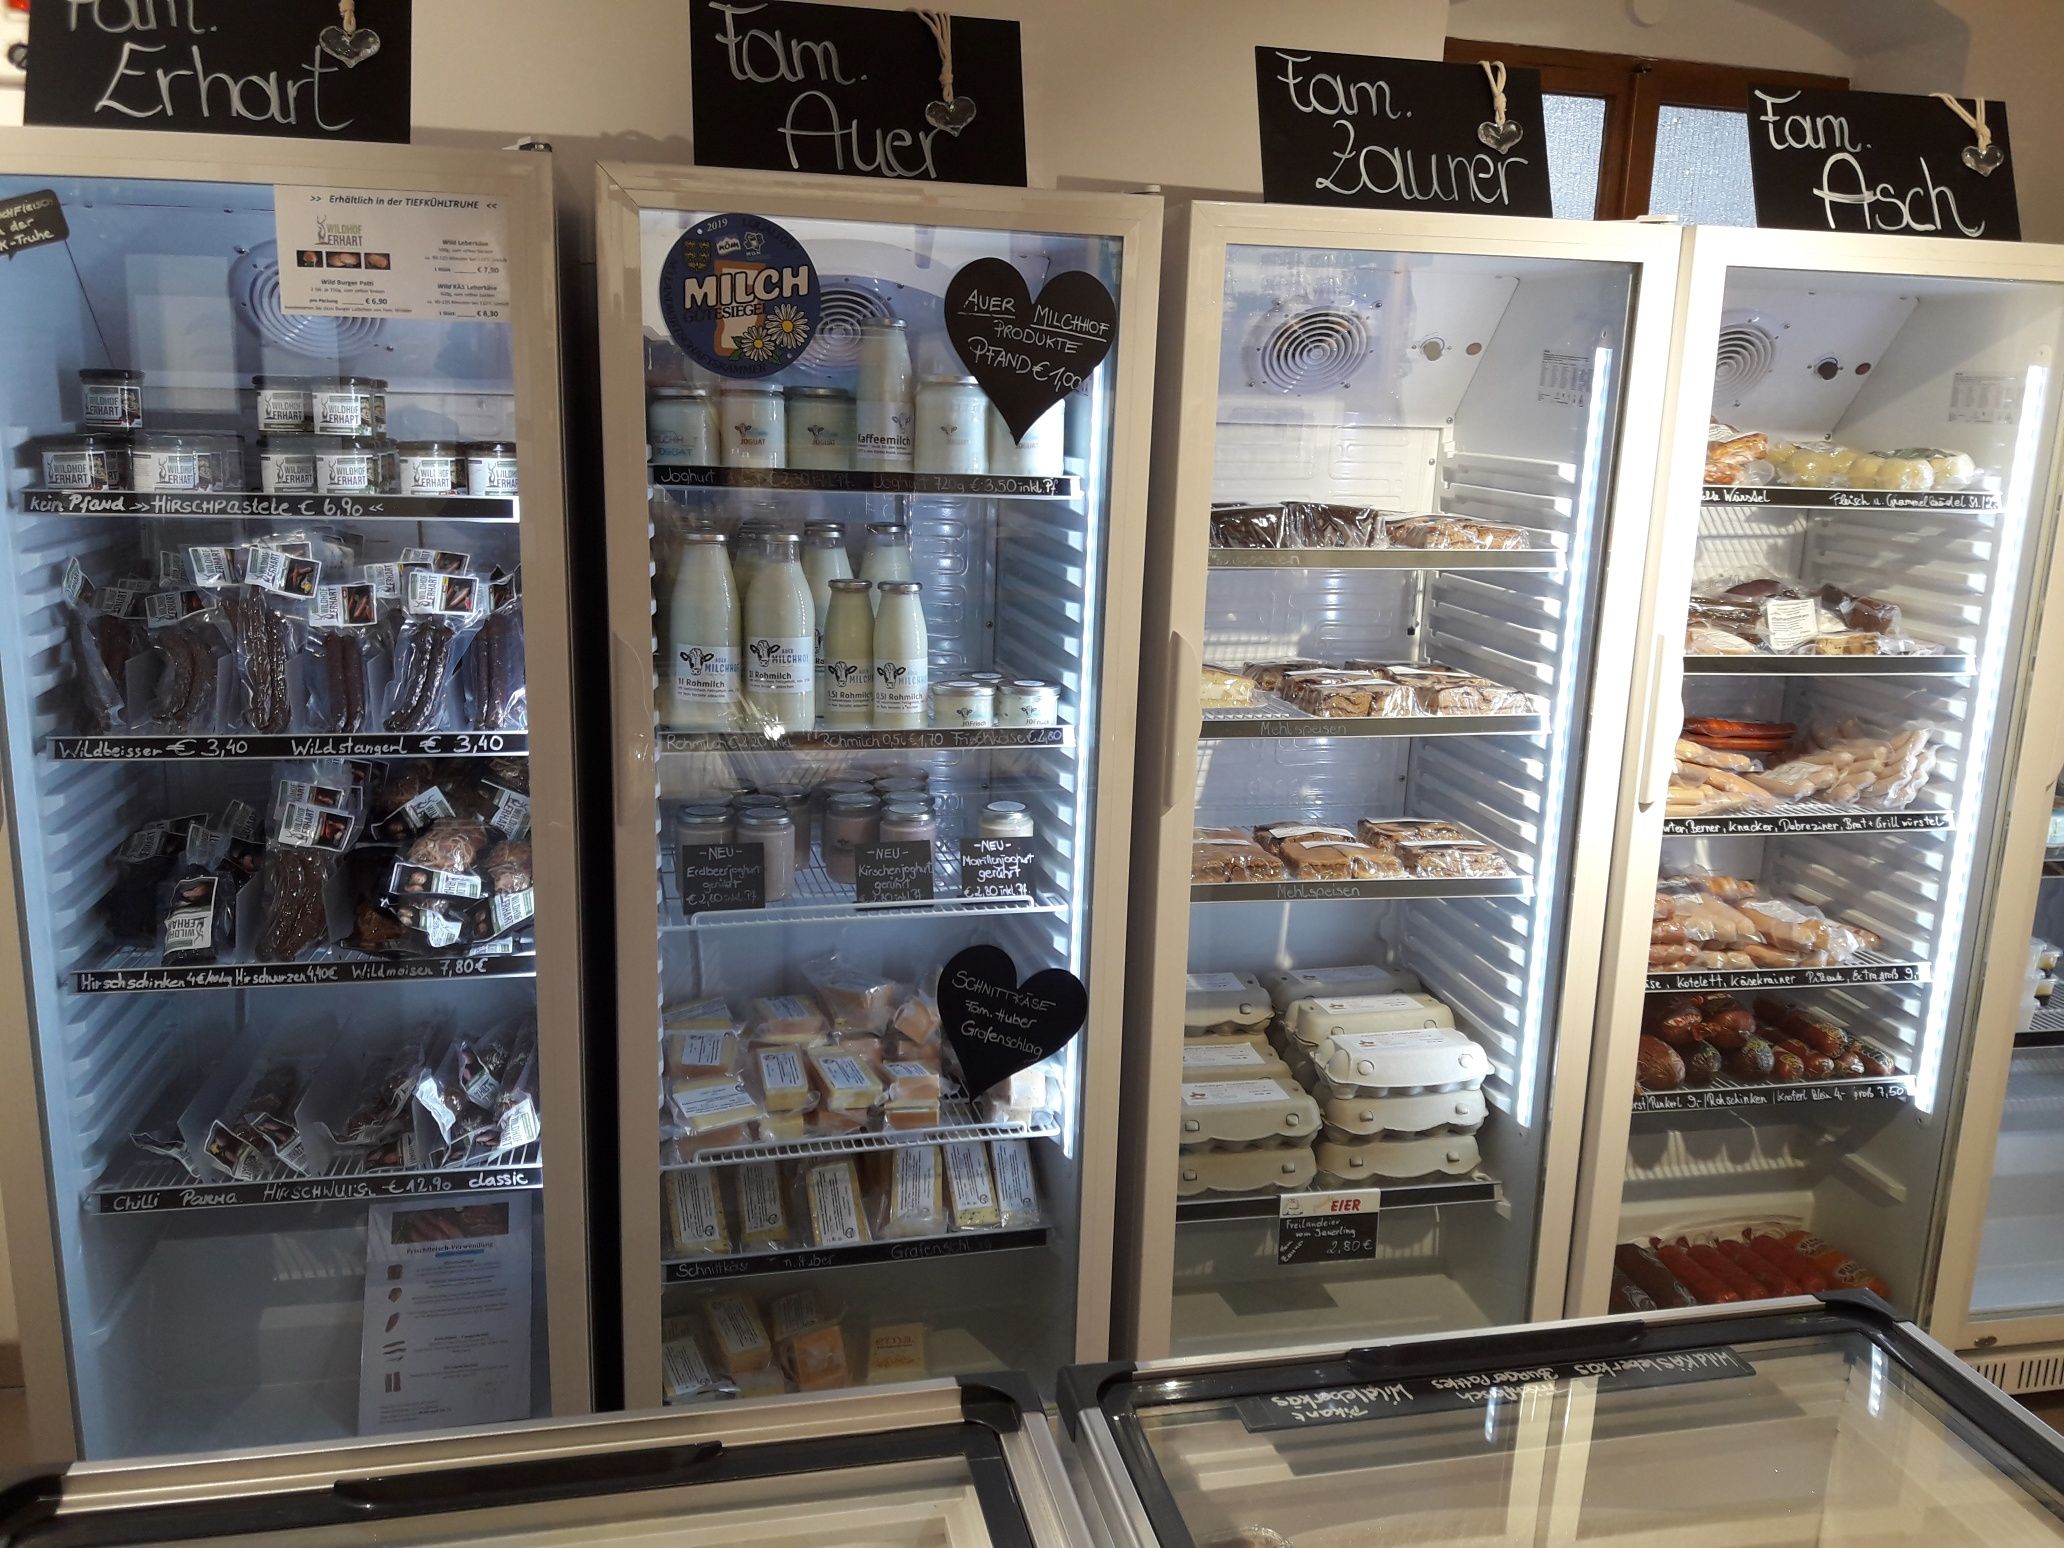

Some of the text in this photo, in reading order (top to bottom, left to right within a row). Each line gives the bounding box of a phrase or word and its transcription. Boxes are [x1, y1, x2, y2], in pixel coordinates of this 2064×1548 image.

[70, 0, 218, 35] am.
[708, 1, 868, 86] Fam.
[95, 42, 354, 131] Erhart
[1275, 51, 1413, 120] Fam.
[1754, 89, 1872, 152] Fam.
[777, 90, 942, 179] Auer
[1315, 120, 1529, 206] Zauner
[329, 194, 374, 205] Erhältlich
[387, 197, 403, 206] der
[405, 197, 480, 209] TIEFKÜHLTRUHE
[1813, 152, 1986, 238] Asch
[327, 224, 362, 235] WILDHOF
[706, 218, 728, 233] 2019
[328, 235, 363, 247] ERHART
[684, 264, 809, 309] MILCH
[963, 289, 1016, 313] AUER
[1033, 305, 1111, 336] MILCHHOF
[993, 319, 1084, 354] PRODUKTE
[968, 336, 1032, 374] PFAND
[1032, 362, 1050, 381] €
[89, 405, 118, 416] ERHART
[53, 463, 88, 474] WILDHOF
[54, 473, 88, 484] ERHART
[660, 468, 716, 485] Joghurt
[285, 475, 314, 484] ERHART
[337, 475, 366, 486] ERHART
[69, 494, 126, 513] Pfand
[323, 499, 364, 518] 6,90
[686, 678, 725, 688] Rohmilch
[755, 671, 792, 680] Rohmilch
[889, 693, 923, 701] Rohmilch
[200, 738, 248, 758] 3,40
[291, 735, 504, 756] Wildstangerl € 3,40
[1276, 883, 1360, 899] Mehlspeisen
[952, 970, 1057, 1012] SCHNITTKÄSE
[965, 1000, 1038, 1028] Fam. Huber
[961, 1020, 1043, 1061] Grafenschlag
[1877, 1086, 1906, 1099] 7,50
[113, 1192, 161, 1212] Chilli
[468, 1171, 529, 1188] classic
[1331, 1199, 1361, 1212] EIER
[1286, 1217, 1341, 1230] Freilandeier
[1326, 1239, 1373, 1254] 2,80 €
